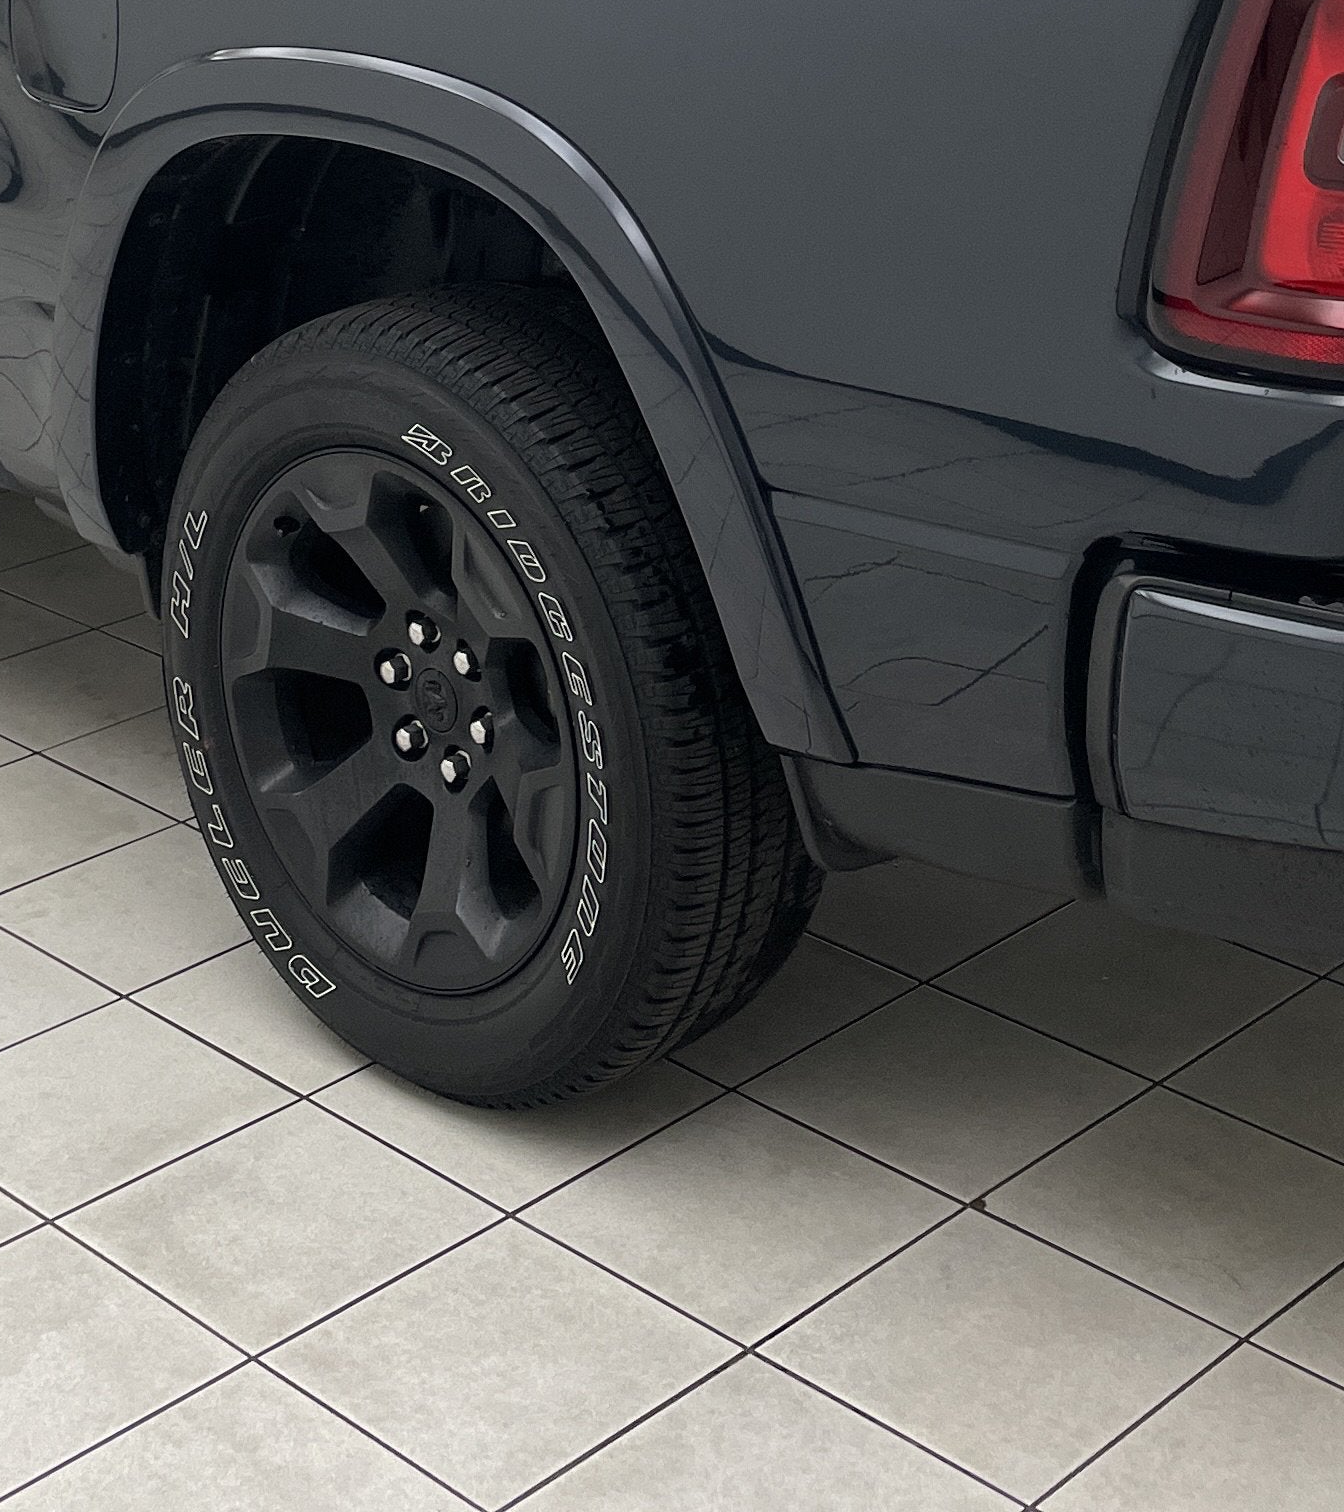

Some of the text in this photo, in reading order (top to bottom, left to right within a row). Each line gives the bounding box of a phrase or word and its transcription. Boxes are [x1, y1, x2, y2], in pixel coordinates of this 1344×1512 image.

[170, 510, 337, 999] DUELER H/L
[400, 423, 608, 985] BRIDGESTONE
